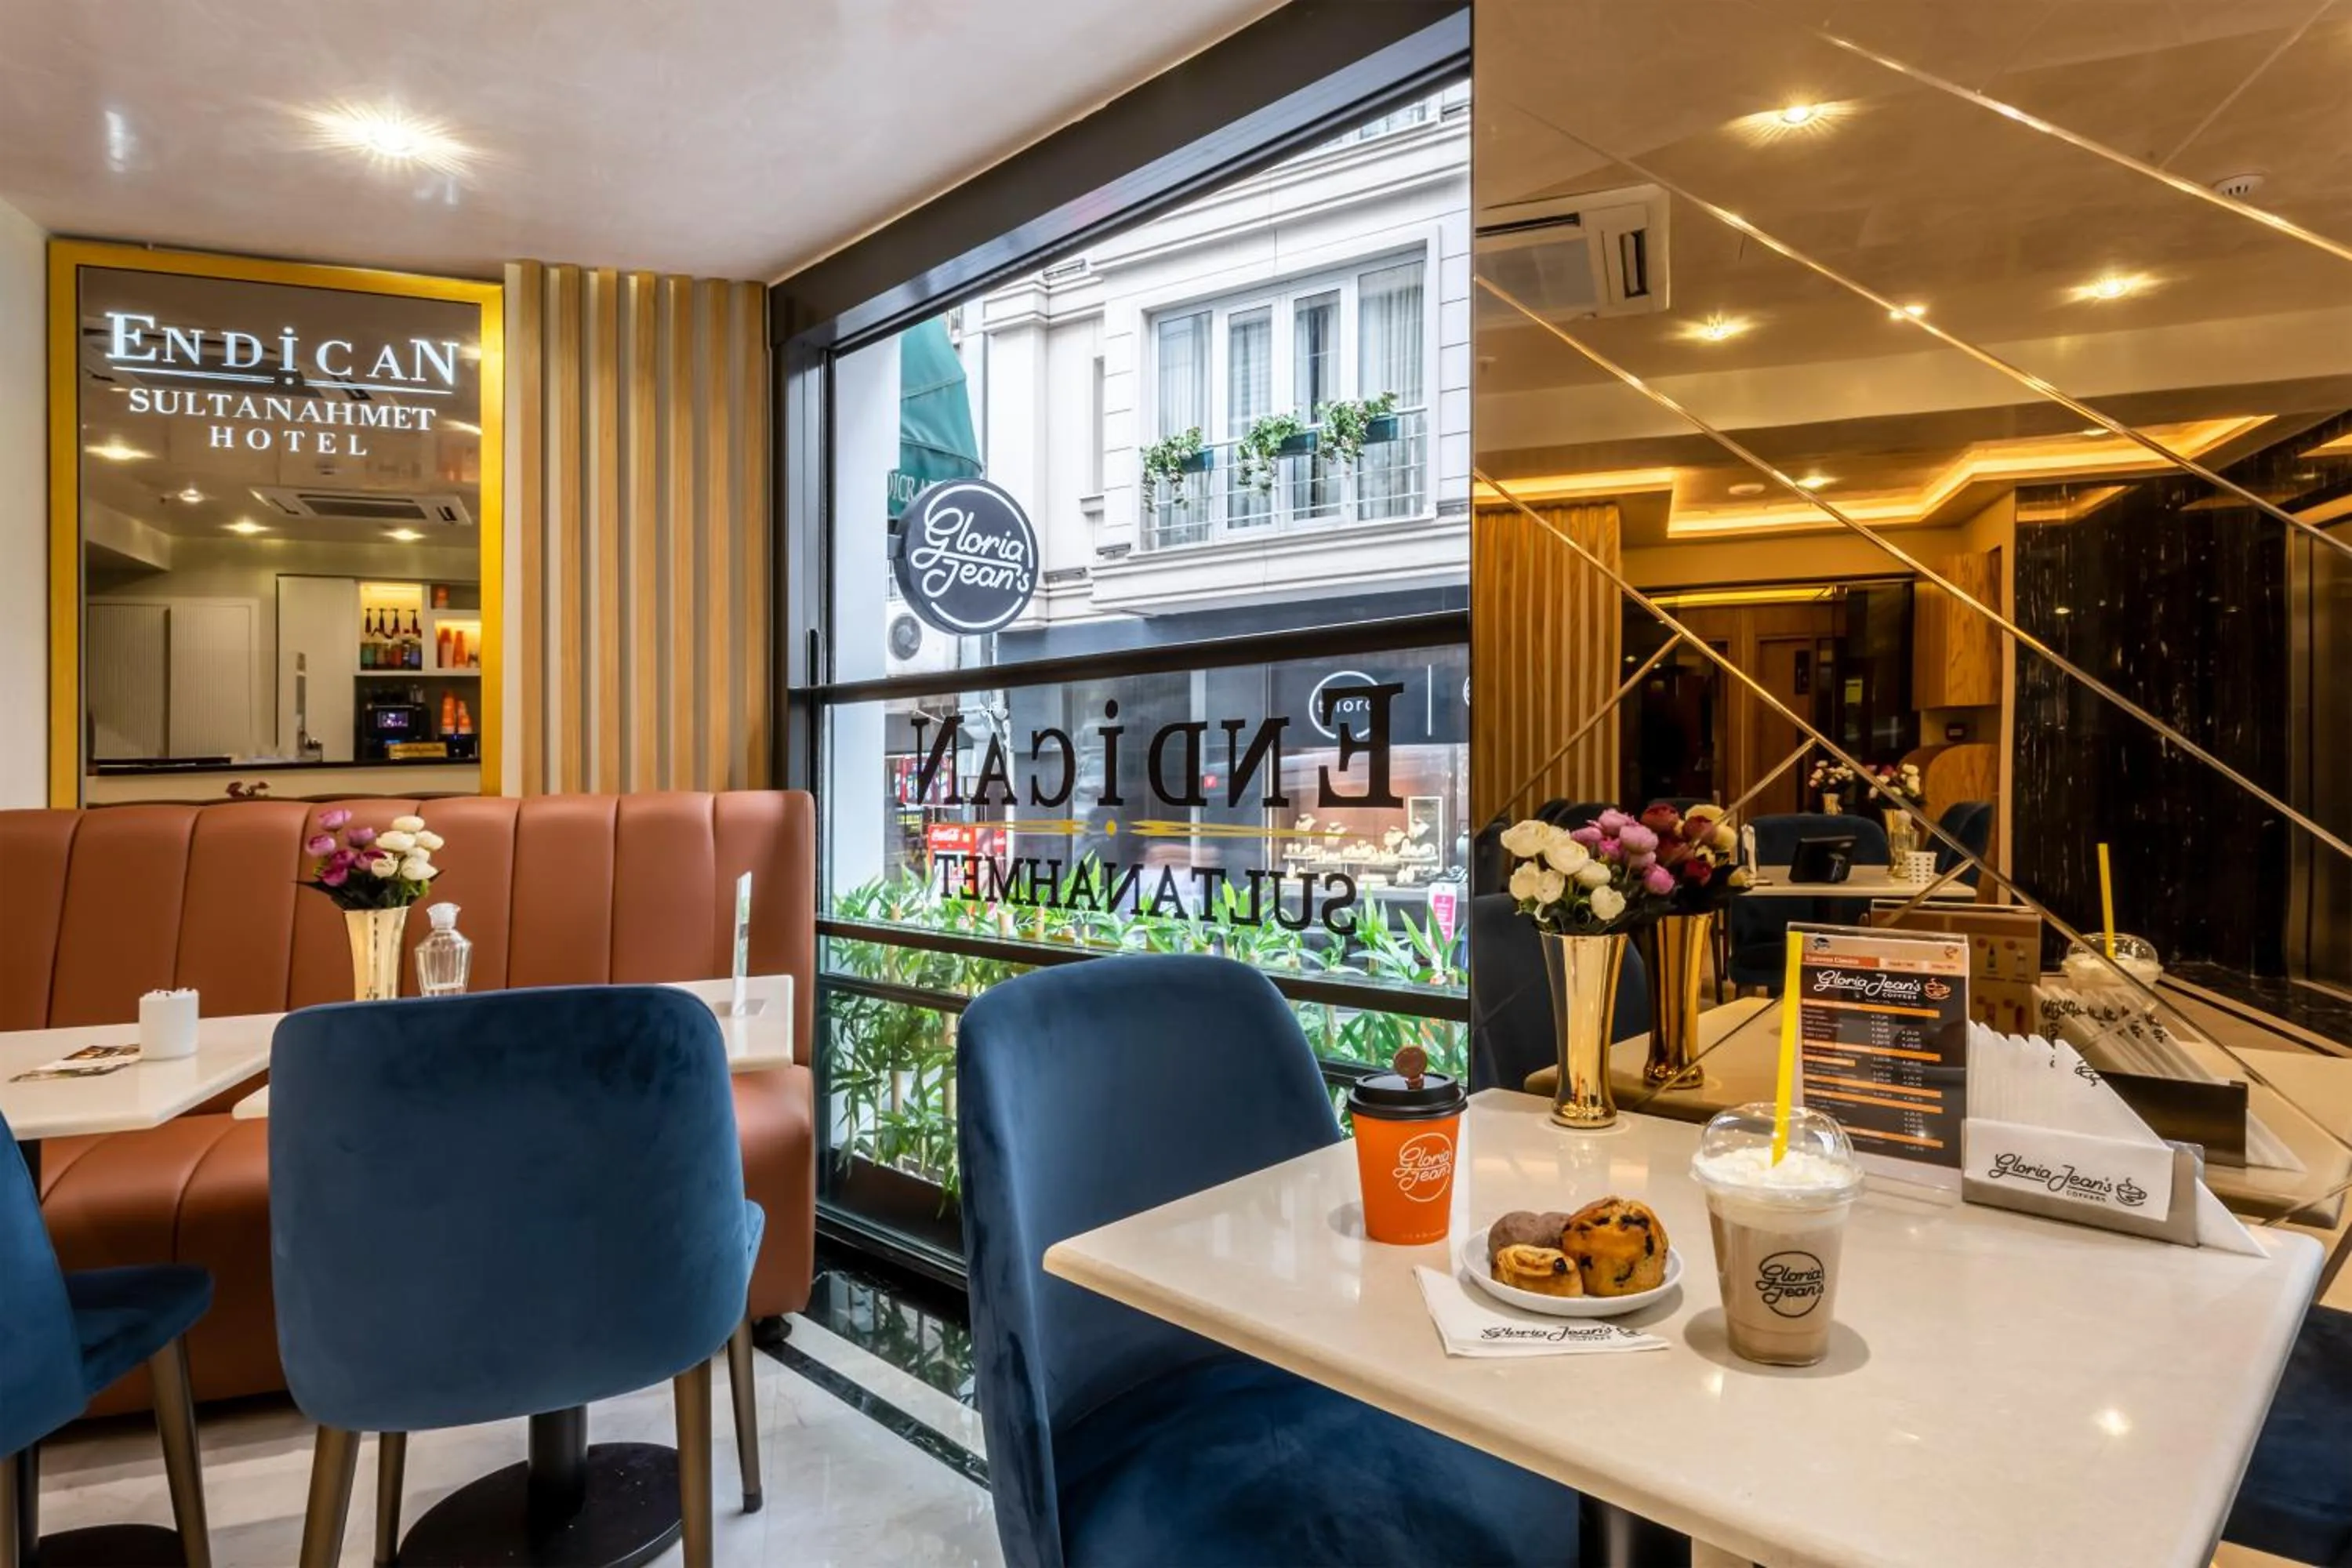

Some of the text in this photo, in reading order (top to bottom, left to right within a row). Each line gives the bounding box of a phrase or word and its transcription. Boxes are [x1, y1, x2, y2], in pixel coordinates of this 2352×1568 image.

[128, 387, 437, 430] SULTANAHMET
[209, 425, 368, 456] HOTEL
[910, 506, 1025, 569] Gloria
[921, 557, 1031, 598] Jean's
[1813, 970, 1922, 996] Gloria Jean's
[1392, 1146, 1450, 1178] Gloria
[1988, 1153, 2112, 1196] Gloria Jean's
[1755, 1264, 1822, 1291] Gloria
